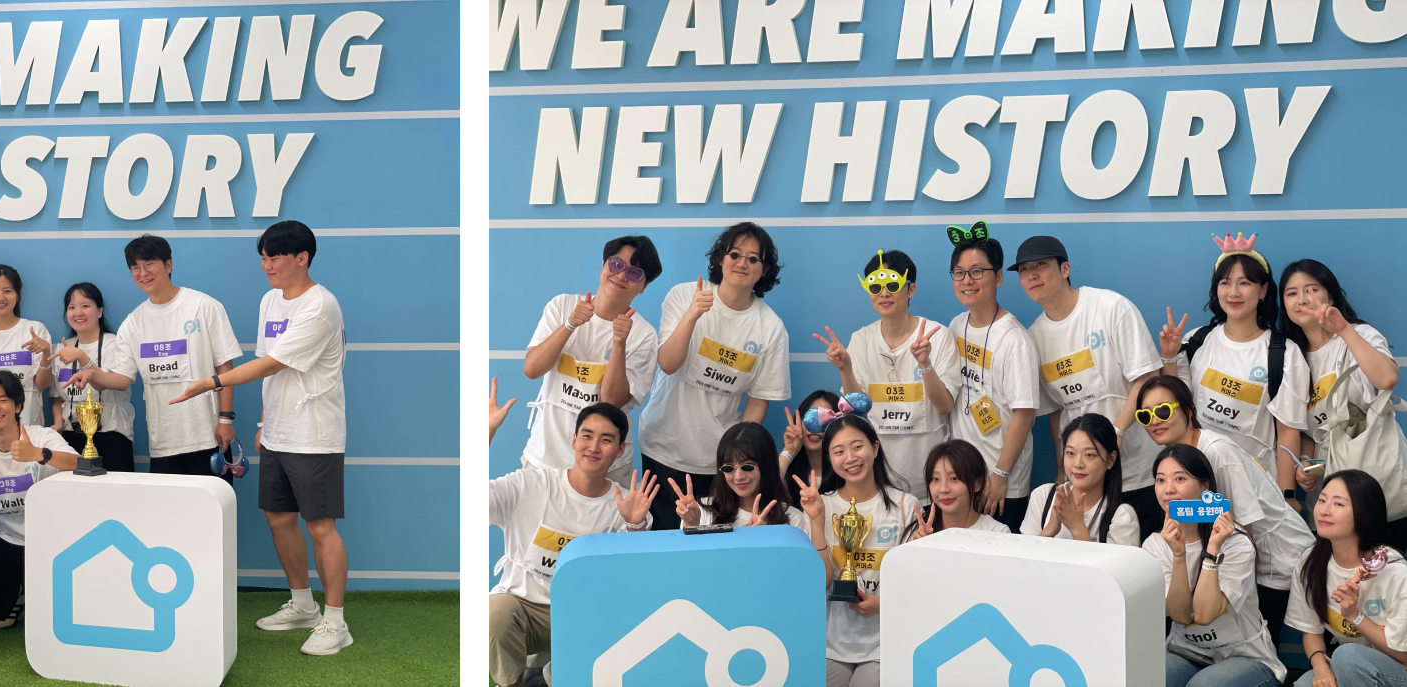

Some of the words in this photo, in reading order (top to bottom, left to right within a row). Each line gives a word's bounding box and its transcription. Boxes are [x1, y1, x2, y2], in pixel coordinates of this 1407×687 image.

[490, 0, 625, 71] WE
[647, 0, 864, 67] ARE
[529, 103, 783, 205] NEW
[801, 86, 1332, 203] HISTORY
[154, 343, 171, 351] 08조
[719, 348, 738, 361] 03조
[149, 360, 178, 373] Bread
[576, 366, 590, 376] 3조
[1056, 358, 1073, 371] 03조
[703, 367, 737, 385] Siwol
[886, 387, 905, 395] 03조
[1061, 383, 1082, 395] Teo
[1221, 377, 1242, 392] 03조
[562, 382, 599, 402] Mason
[1221, 387, 1237, 398] 커머스
[882, 409, 911, 421] Jerry
[1207, 398, 1240, 419] Zoey
[1176, 507, 1194, 516] 홈팀
[1197, 506, 1223, 516] 응원해
[853, 552, 875, 562] 03조
